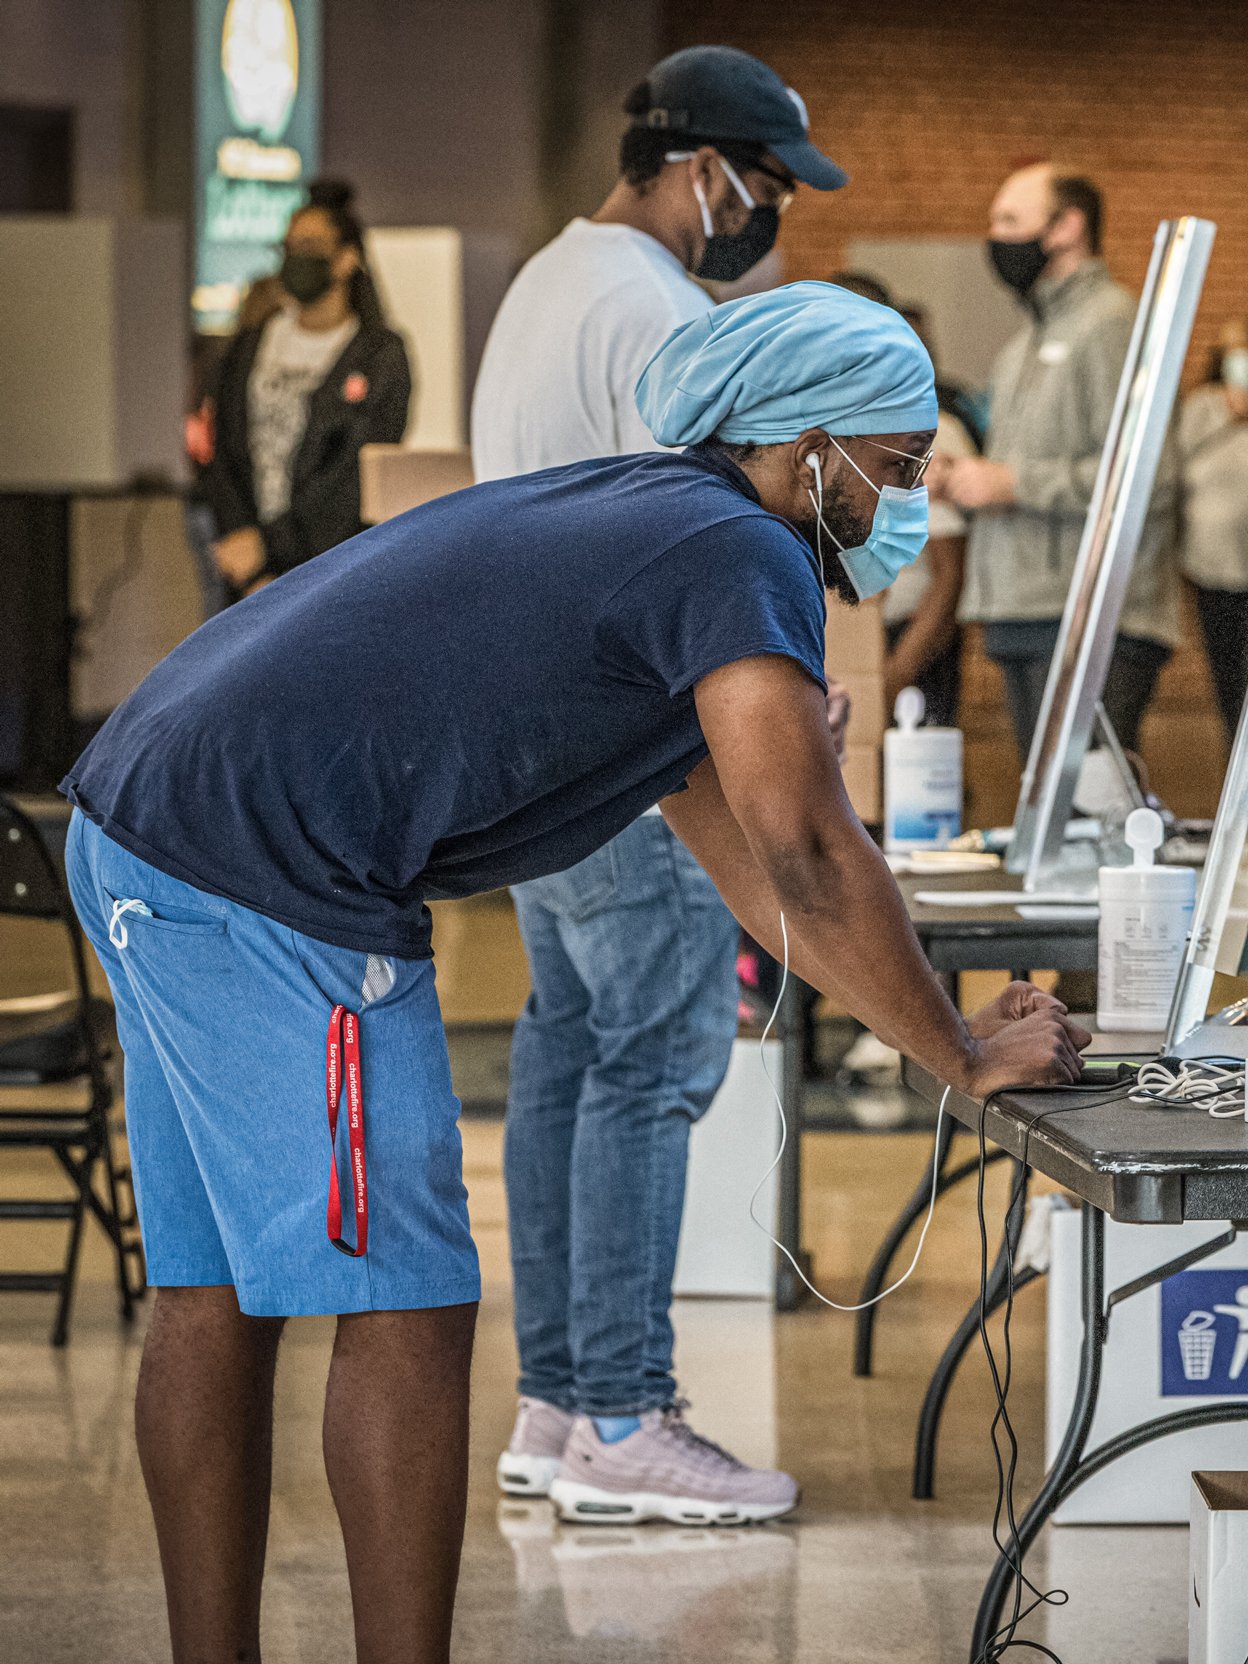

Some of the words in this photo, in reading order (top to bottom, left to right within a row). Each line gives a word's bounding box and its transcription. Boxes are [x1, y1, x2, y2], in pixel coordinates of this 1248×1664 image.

[329, 1043, 338, 1108] charlottefire.org
[349, 1063, 359, 1129] charlottefire.org
[354, 1147, 364, 1213] charlottefire.org
